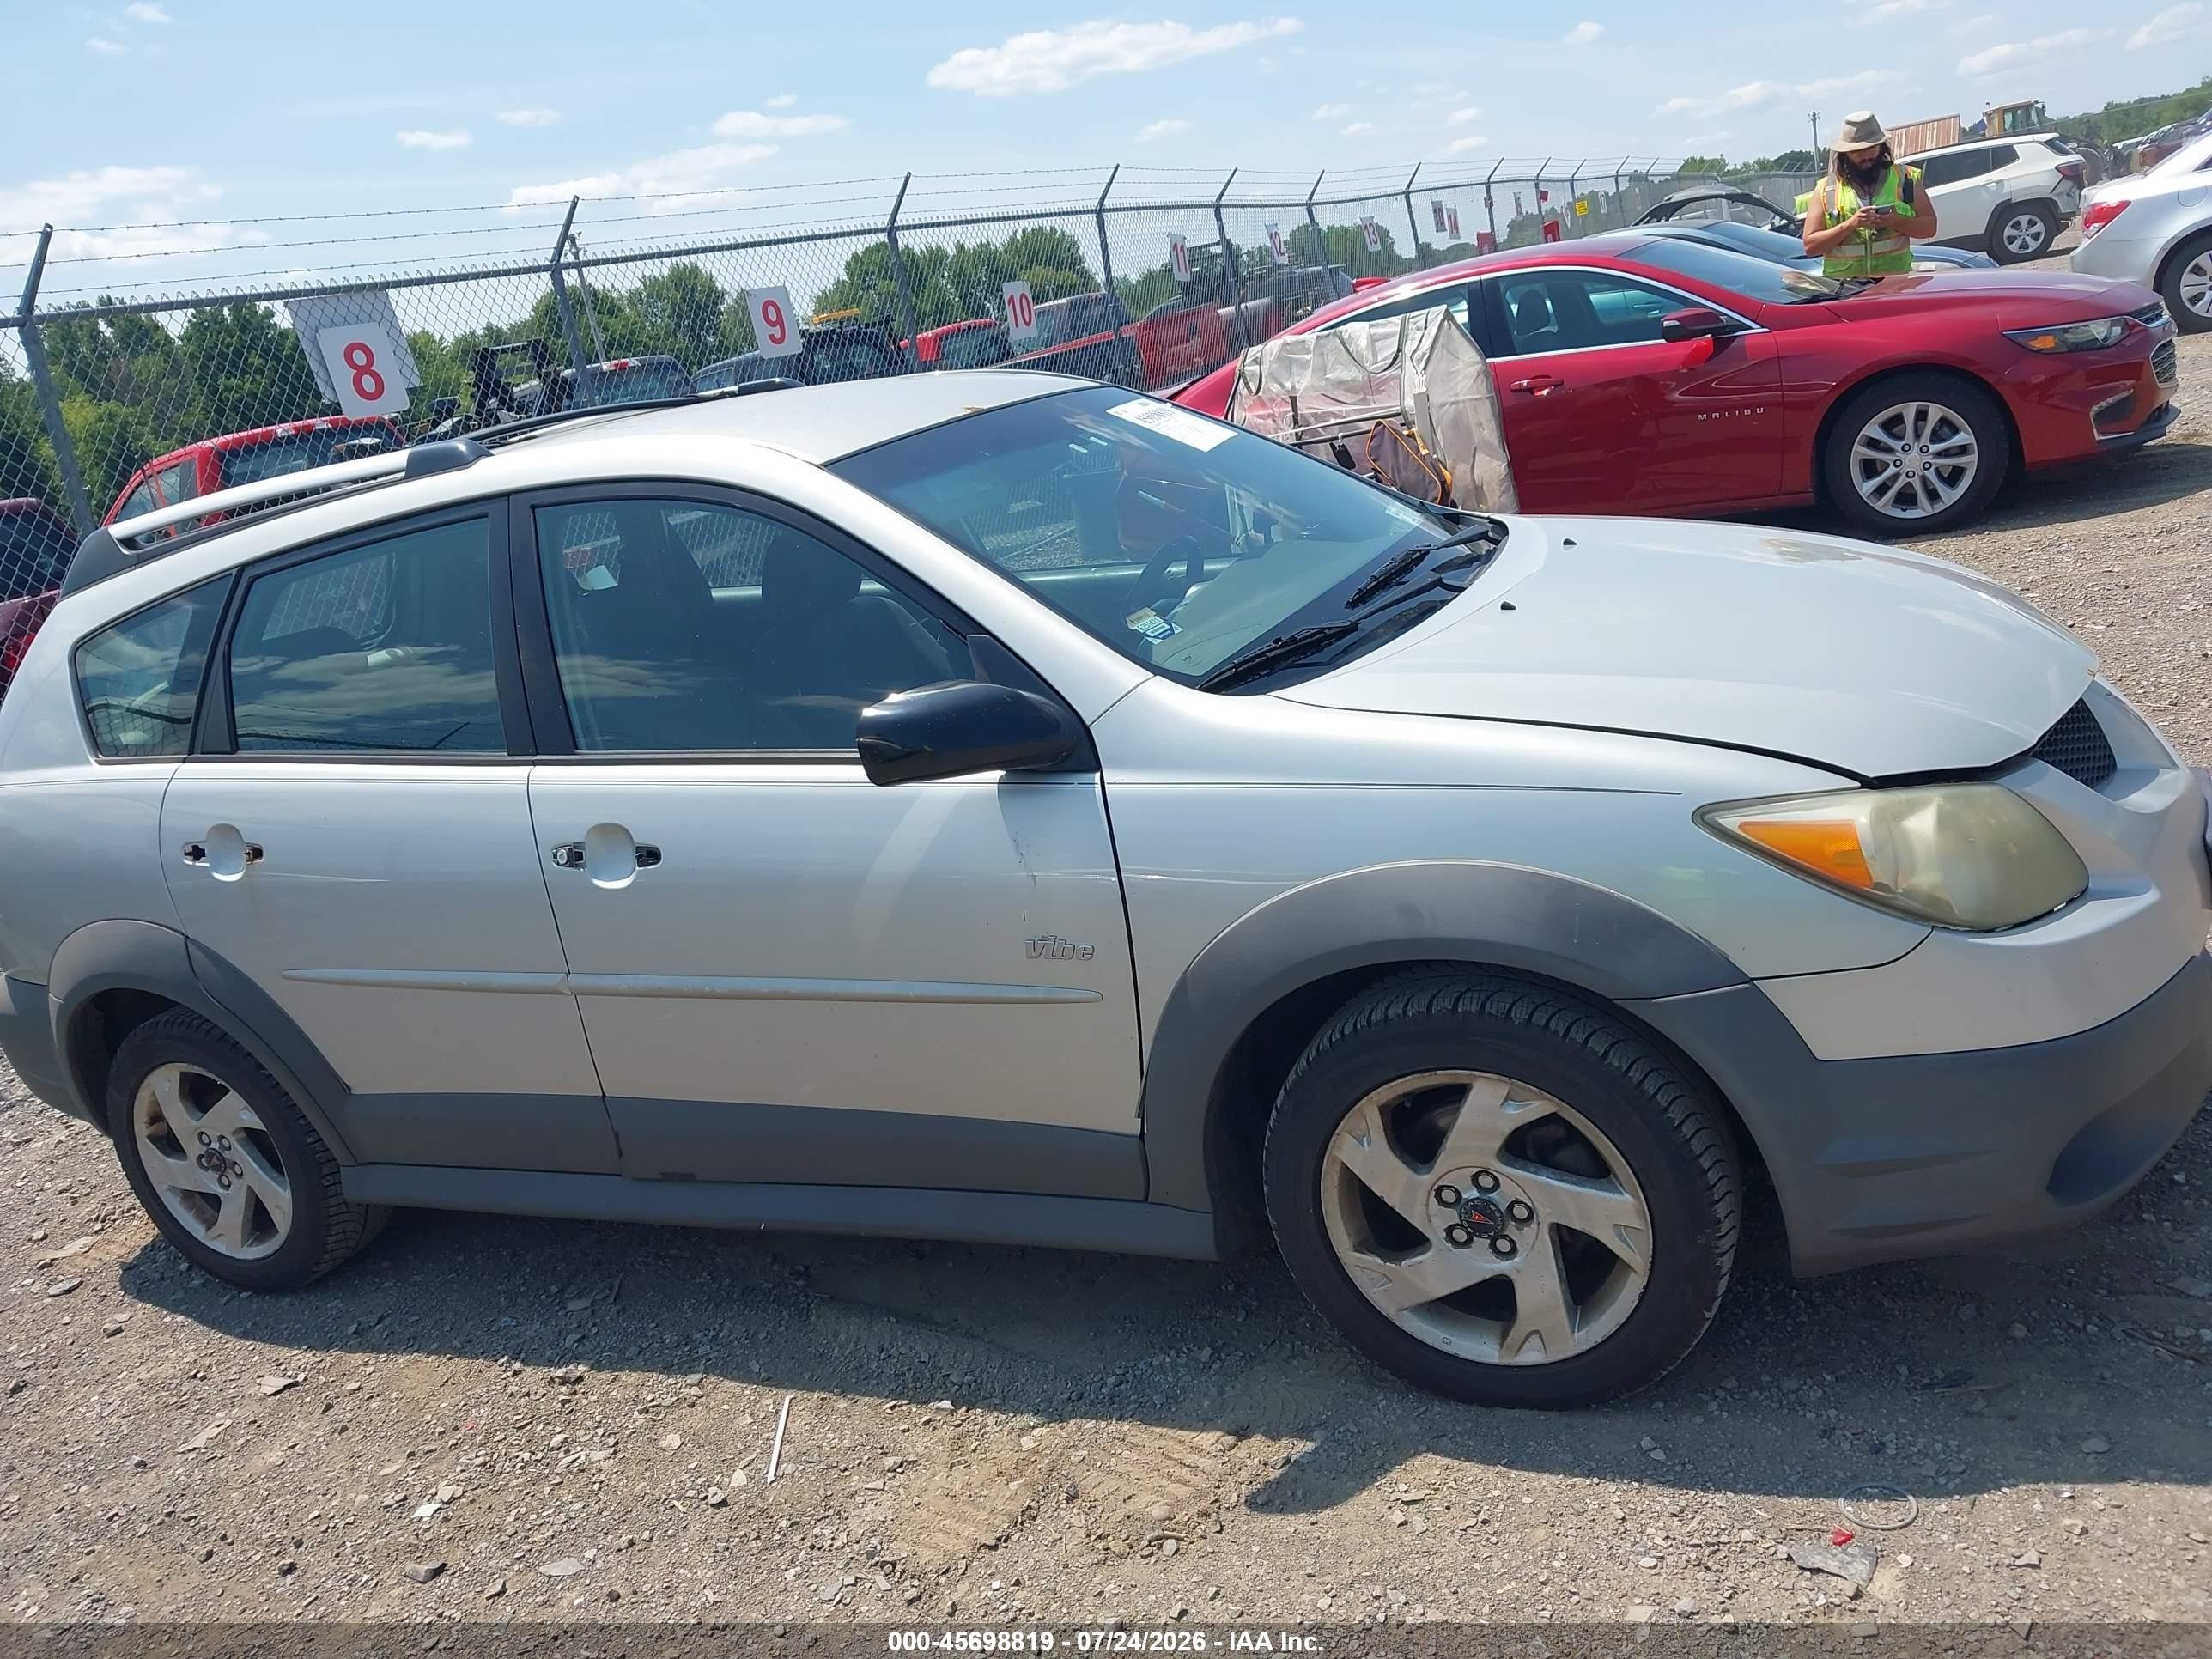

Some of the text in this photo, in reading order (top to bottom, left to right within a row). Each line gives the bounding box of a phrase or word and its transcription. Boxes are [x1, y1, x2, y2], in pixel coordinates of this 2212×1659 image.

[1364, 222, 1379, 246] 13
[1448, 214, 1460, 234] 14
[1172, 242, 1189, 273] 11
[1269, 232, 1285, 257] 12
[761, 298, 787, 345] 9
[1007, 292, 1032, 328] 10
[343, 342, 386, 401] 8
[1698, 407, 1764, 420] MALIBU
